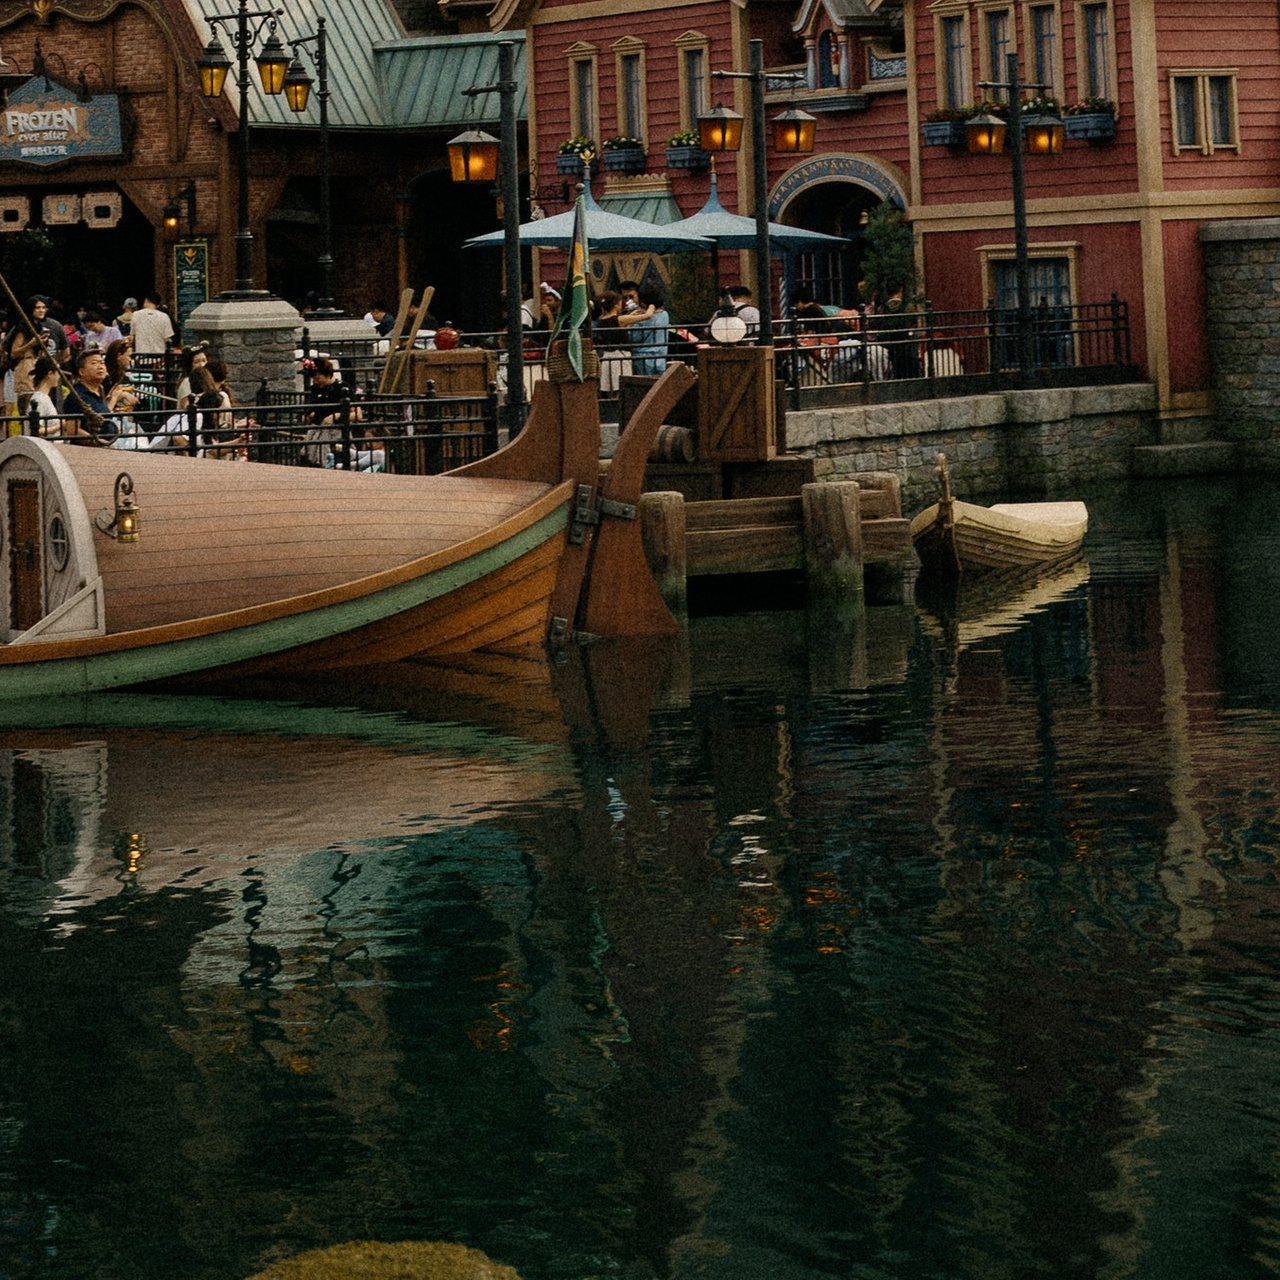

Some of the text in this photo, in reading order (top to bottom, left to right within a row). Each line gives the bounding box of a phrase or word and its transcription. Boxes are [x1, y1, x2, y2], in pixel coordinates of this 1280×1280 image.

[5, 106, 79, 136] FROZEN
[18, 130, 69, 143] ever after
